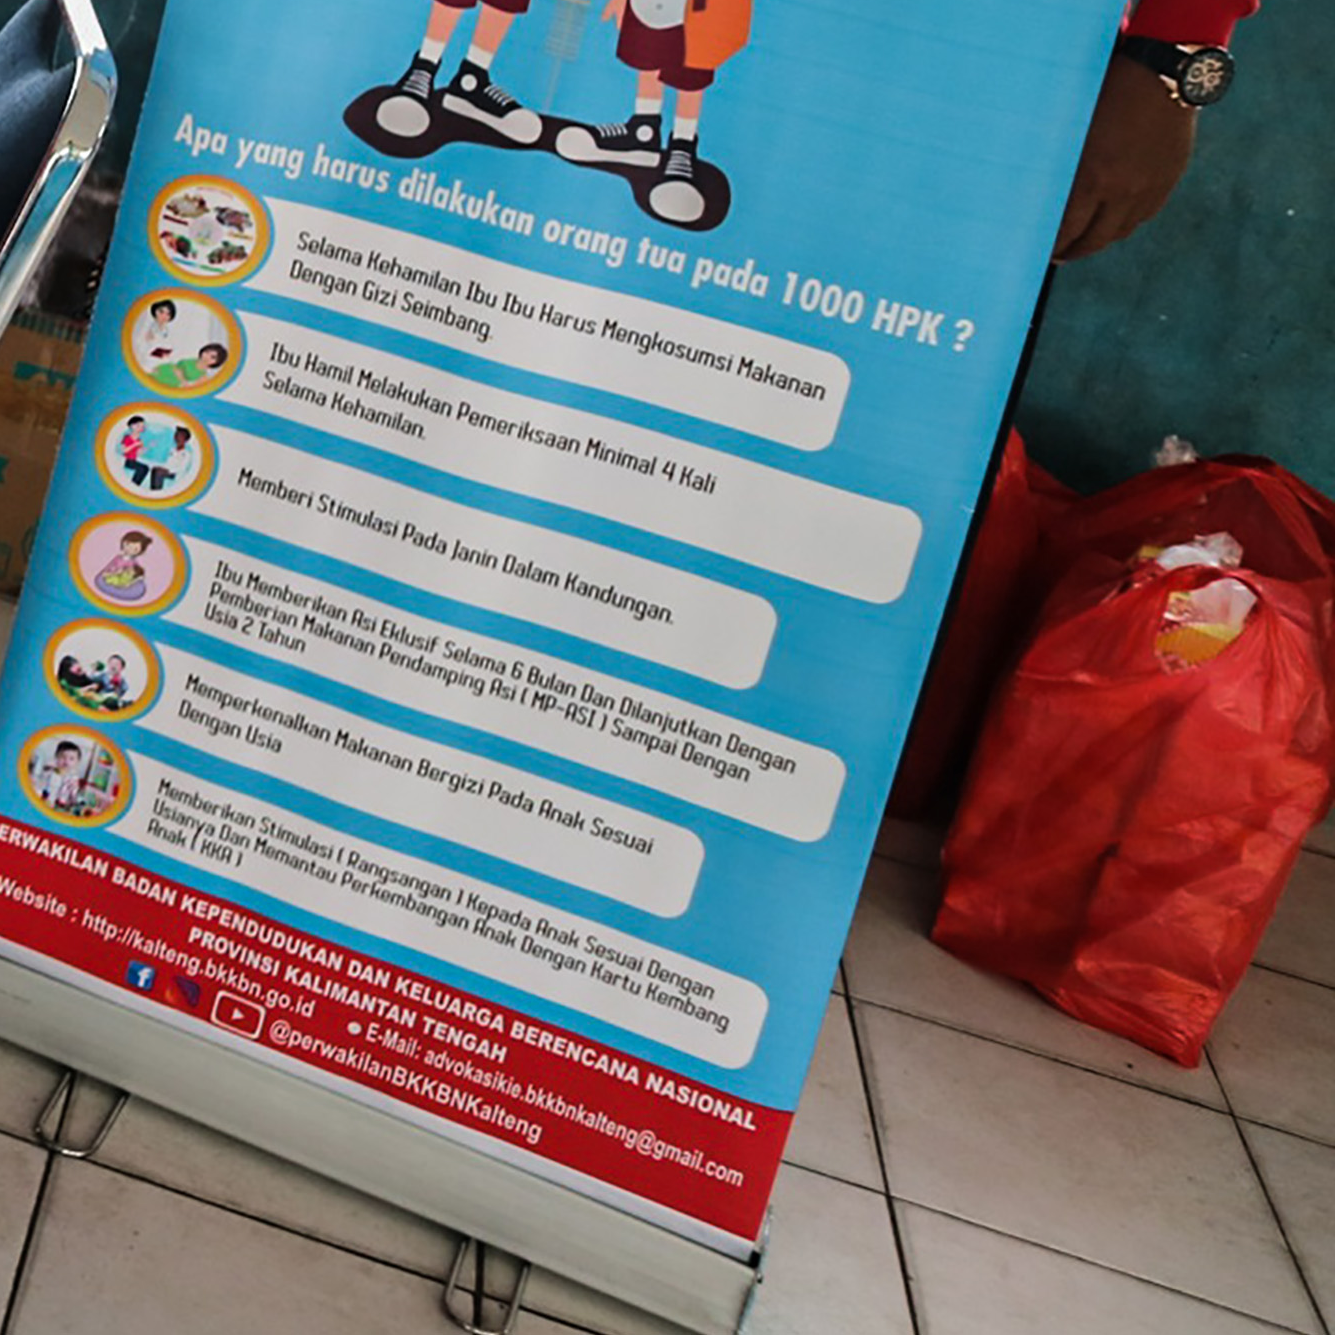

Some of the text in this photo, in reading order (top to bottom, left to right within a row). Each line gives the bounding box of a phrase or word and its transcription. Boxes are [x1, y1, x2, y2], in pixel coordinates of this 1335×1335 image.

[173, 112, 975, 352] Apa yang harus dilakukan orang tua pada 1000 HPK ?
[289, 259, 357, 296] Dengan
[361, 279, 397, 307] Gizi
[262, 370, 327, 406] Selama
[296, 231, 826, 400] Selama Kehamilan Ibu Ibu Harus Mengkosumsi Makanan
[269, 341, 301, 368] Ibu
[303, 352, 354, 384] Hamil
[356, 368, 452, 417] Melakukan
[456, 401, 580, 453] Pemeriksaan
[584, 437, 657, 475] Minimal
[678, 465, 716, 494] Kali
[237, 467, 313, 508] Memberi
[316, 493, 398, 537] Stimulasi
[401, 522, 447, 554] Pada
[450, 539, 498, 569] Janin
[501, 553, 560, 587] Dalam
[203, 601, 238, 630] Usia
[258, 620, 306, 653] Tahun
[208, 581, 298, 627] Pemberian
[301, 613, 375, 655] Makanan
[378, 641, 485, 696] Pendamping
[488, 677, 516, 701] Asi
[530, 690, 596, 728] MP-ASI
[610, 717, 678, 756] Sampai
[680, 741, 750, 782] Dengan
[214, 560, 243, 586] Ibu
[245, 571, 347, 622] Memberikan
[350, 608, 376, 632] Asi
[379, 618, 438, 653] Eklusif
[442, 640, 506, 675] Selama
[526, 665, 577, 697] Bulan
[579, 683, 615, 710] Dan
[618, 696, 722, 747] Dilanjutkan
[725, 732, 796, 774] Dengan
[177, 698, 282, 753] Dengan Usia
[184, 673, 653, 854] Memperkenalkan Makanan Bergizi Pada Anak Sesuai
[146, 817, 186, 847] Anak
[199, 838, 233, 863] KKA
[152, 797, 729, 1034] Usianya Dan Memantau Perkembangan Anak Dengan Kartu Kembang
[157, 777, 255, 828] Memberikan
[258, 816, 333, 860] Stimulasi
[346, 850, 452, 901] Rangsangan
[465, 892, 531, 931] Kepada
[534, 917, 579, 948] Anak
[583, 935, 643, 972] Sesuai
[646, 958, 715, 1000] Dengan
[82, 907, 315, 1017] http://kalteng.bkkbn.go.id
[111, 866, 177, 906] BADAN
[180, 893, 343, 971] KEPENDUDUKAN
[346, 959, 391, 988] DAN
[393, 976, 504, 1032] KELUARGA
[509, 1020, 639, 1084] BERENCANA
[645, 1072, 756, 1130] NASIONAL
[187, 926, 507, 1063] PROVINSI KALIMANTAN TENGAH
[269, 1019, 542, 1144] @perwakilanBKKBNKalteng
[365, 1020, 744, 1186] E-Mail: advokasikie.bkkbnkalteng@gmail.com
